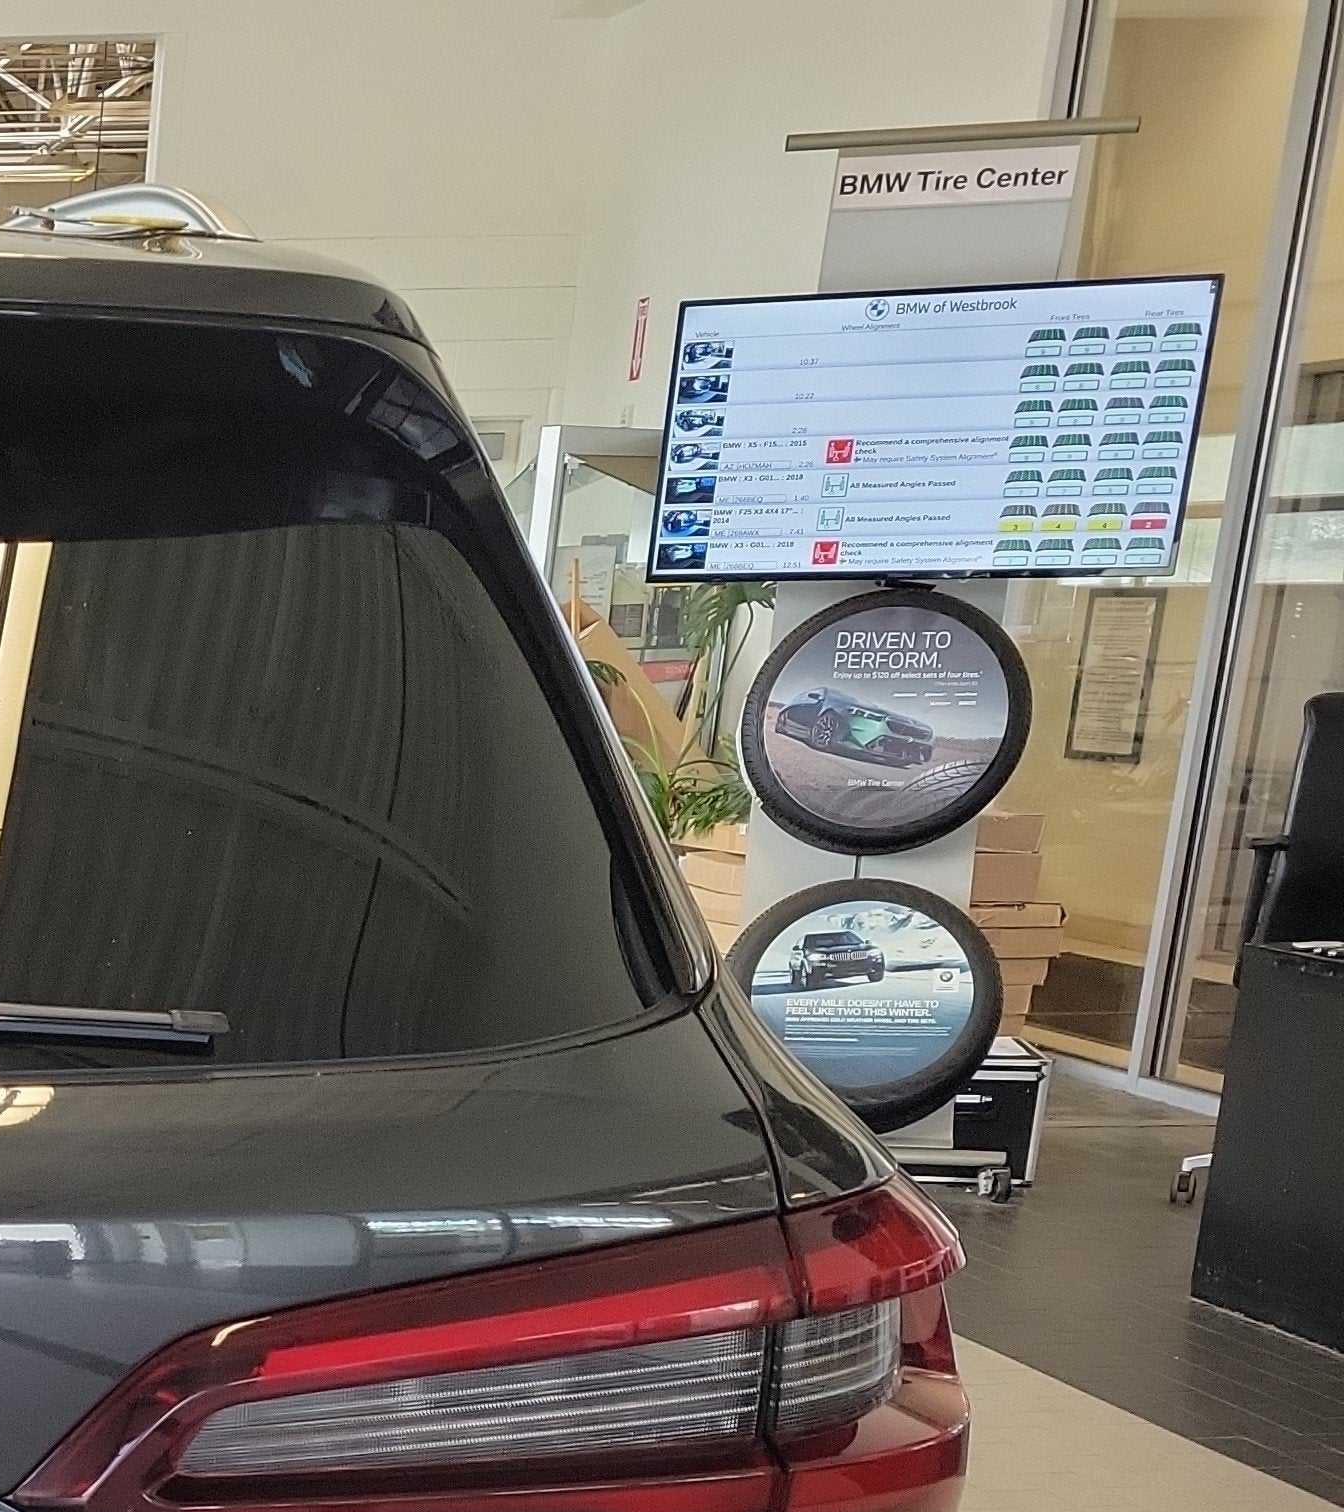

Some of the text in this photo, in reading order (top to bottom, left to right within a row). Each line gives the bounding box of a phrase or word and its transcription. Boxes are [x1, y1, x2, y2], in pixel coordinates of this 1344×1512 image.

[839, 167, 1069, 195] BMW Tire Center
[896, 302, 931, 314] BMW
[933, 300, 947, 313] of
[950, 298, 1017, 312] Westbrook
[865, 323, 901, 331] Alignment
[911, 436, 969, 445] comprehensive
[971, 436, 1010, 444] alignment
[930, 454, 957, 462] System
[862, 481, 898, 489] Measured
[900, 481, 926, 489] Angles
[896, 540, 953, 548] comprehensive
[955, 539, 993, 547] alignment
[891, 557, 913, 565] Safety
[914, 556, 942, 564] System
[836, 631, 952, 649] DRIVEN TO
[833, 651, 942, 669] PERFORM.
[786, 998, 939, 1008] EVERY MILE DOESN'T HAVE TO
[812, 1007, 835, 1015] LIKE
[863, 1008, 887, 1016] THIS
[888, 1008, 932, 1017] WINTER.
